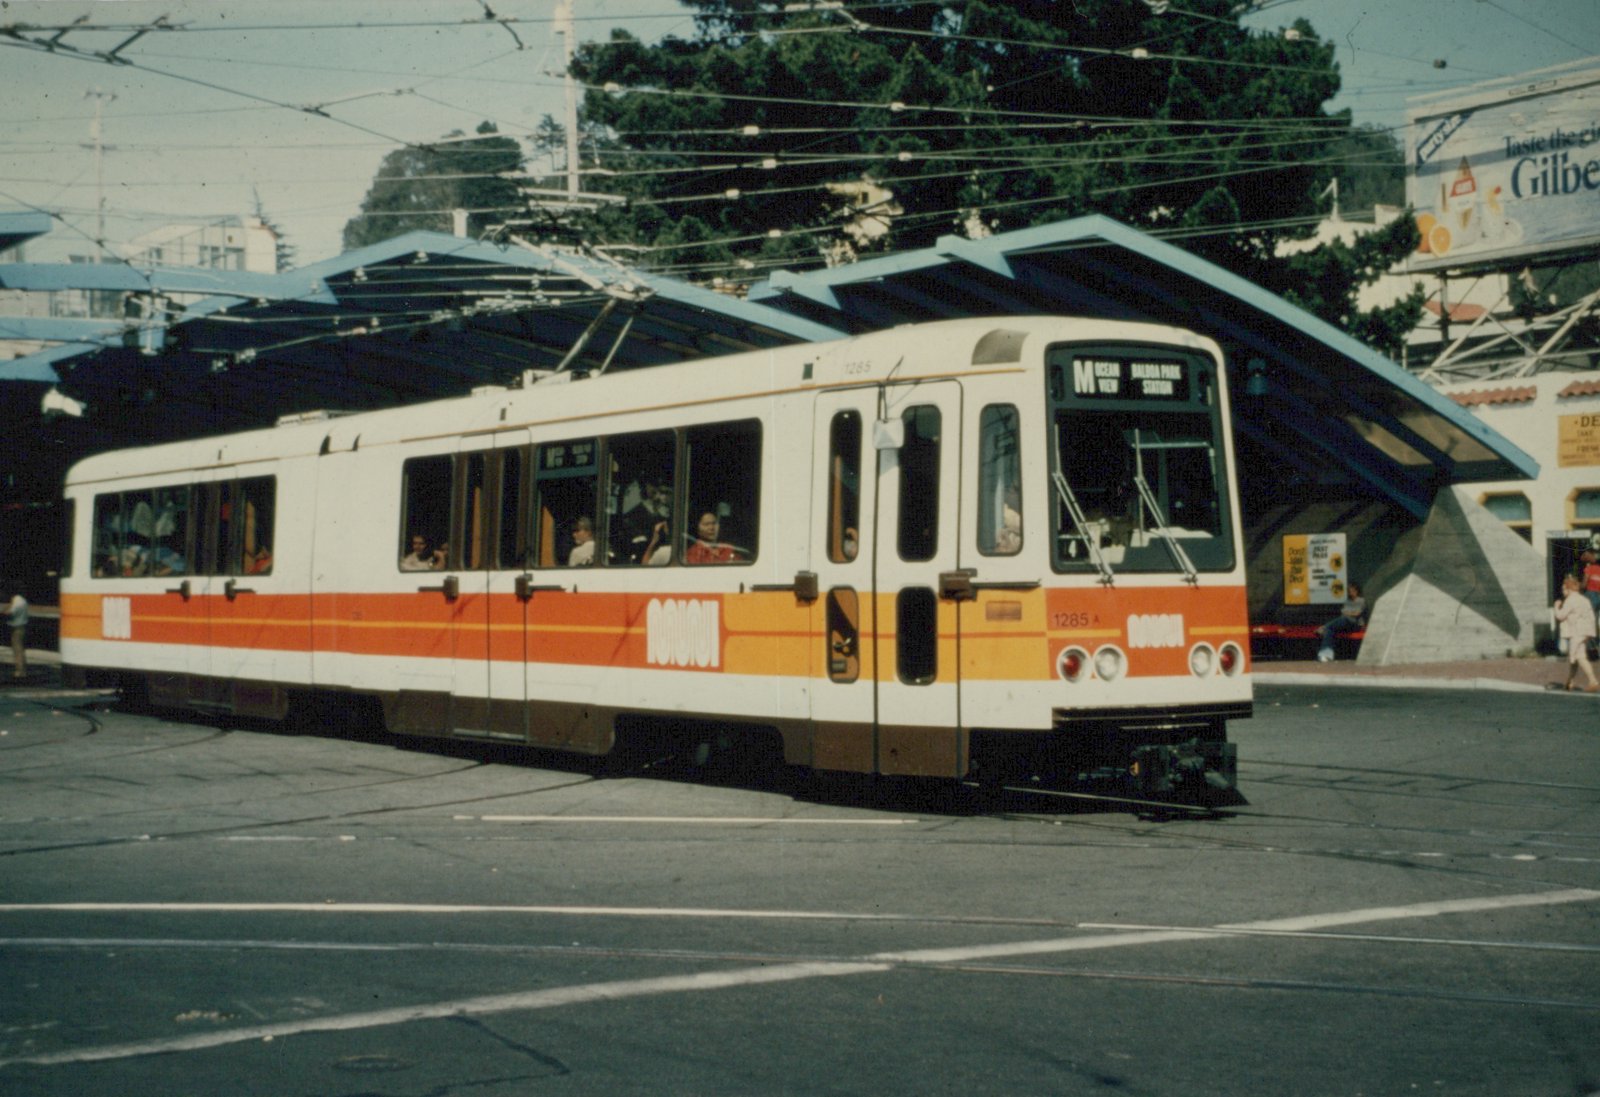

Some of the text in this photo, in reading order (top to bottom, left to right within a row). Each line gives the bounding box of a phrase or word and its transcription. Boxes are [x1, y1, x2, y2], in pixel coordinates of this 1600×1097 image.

[1504, 135, 1546, 158] Taste
[1549, 127, 1576, 149] the
[1511, 150, 1600, 198] Gilbe
[1073, 360, 1095, 393] M
[1053, 612, 1089, 627] 1285
